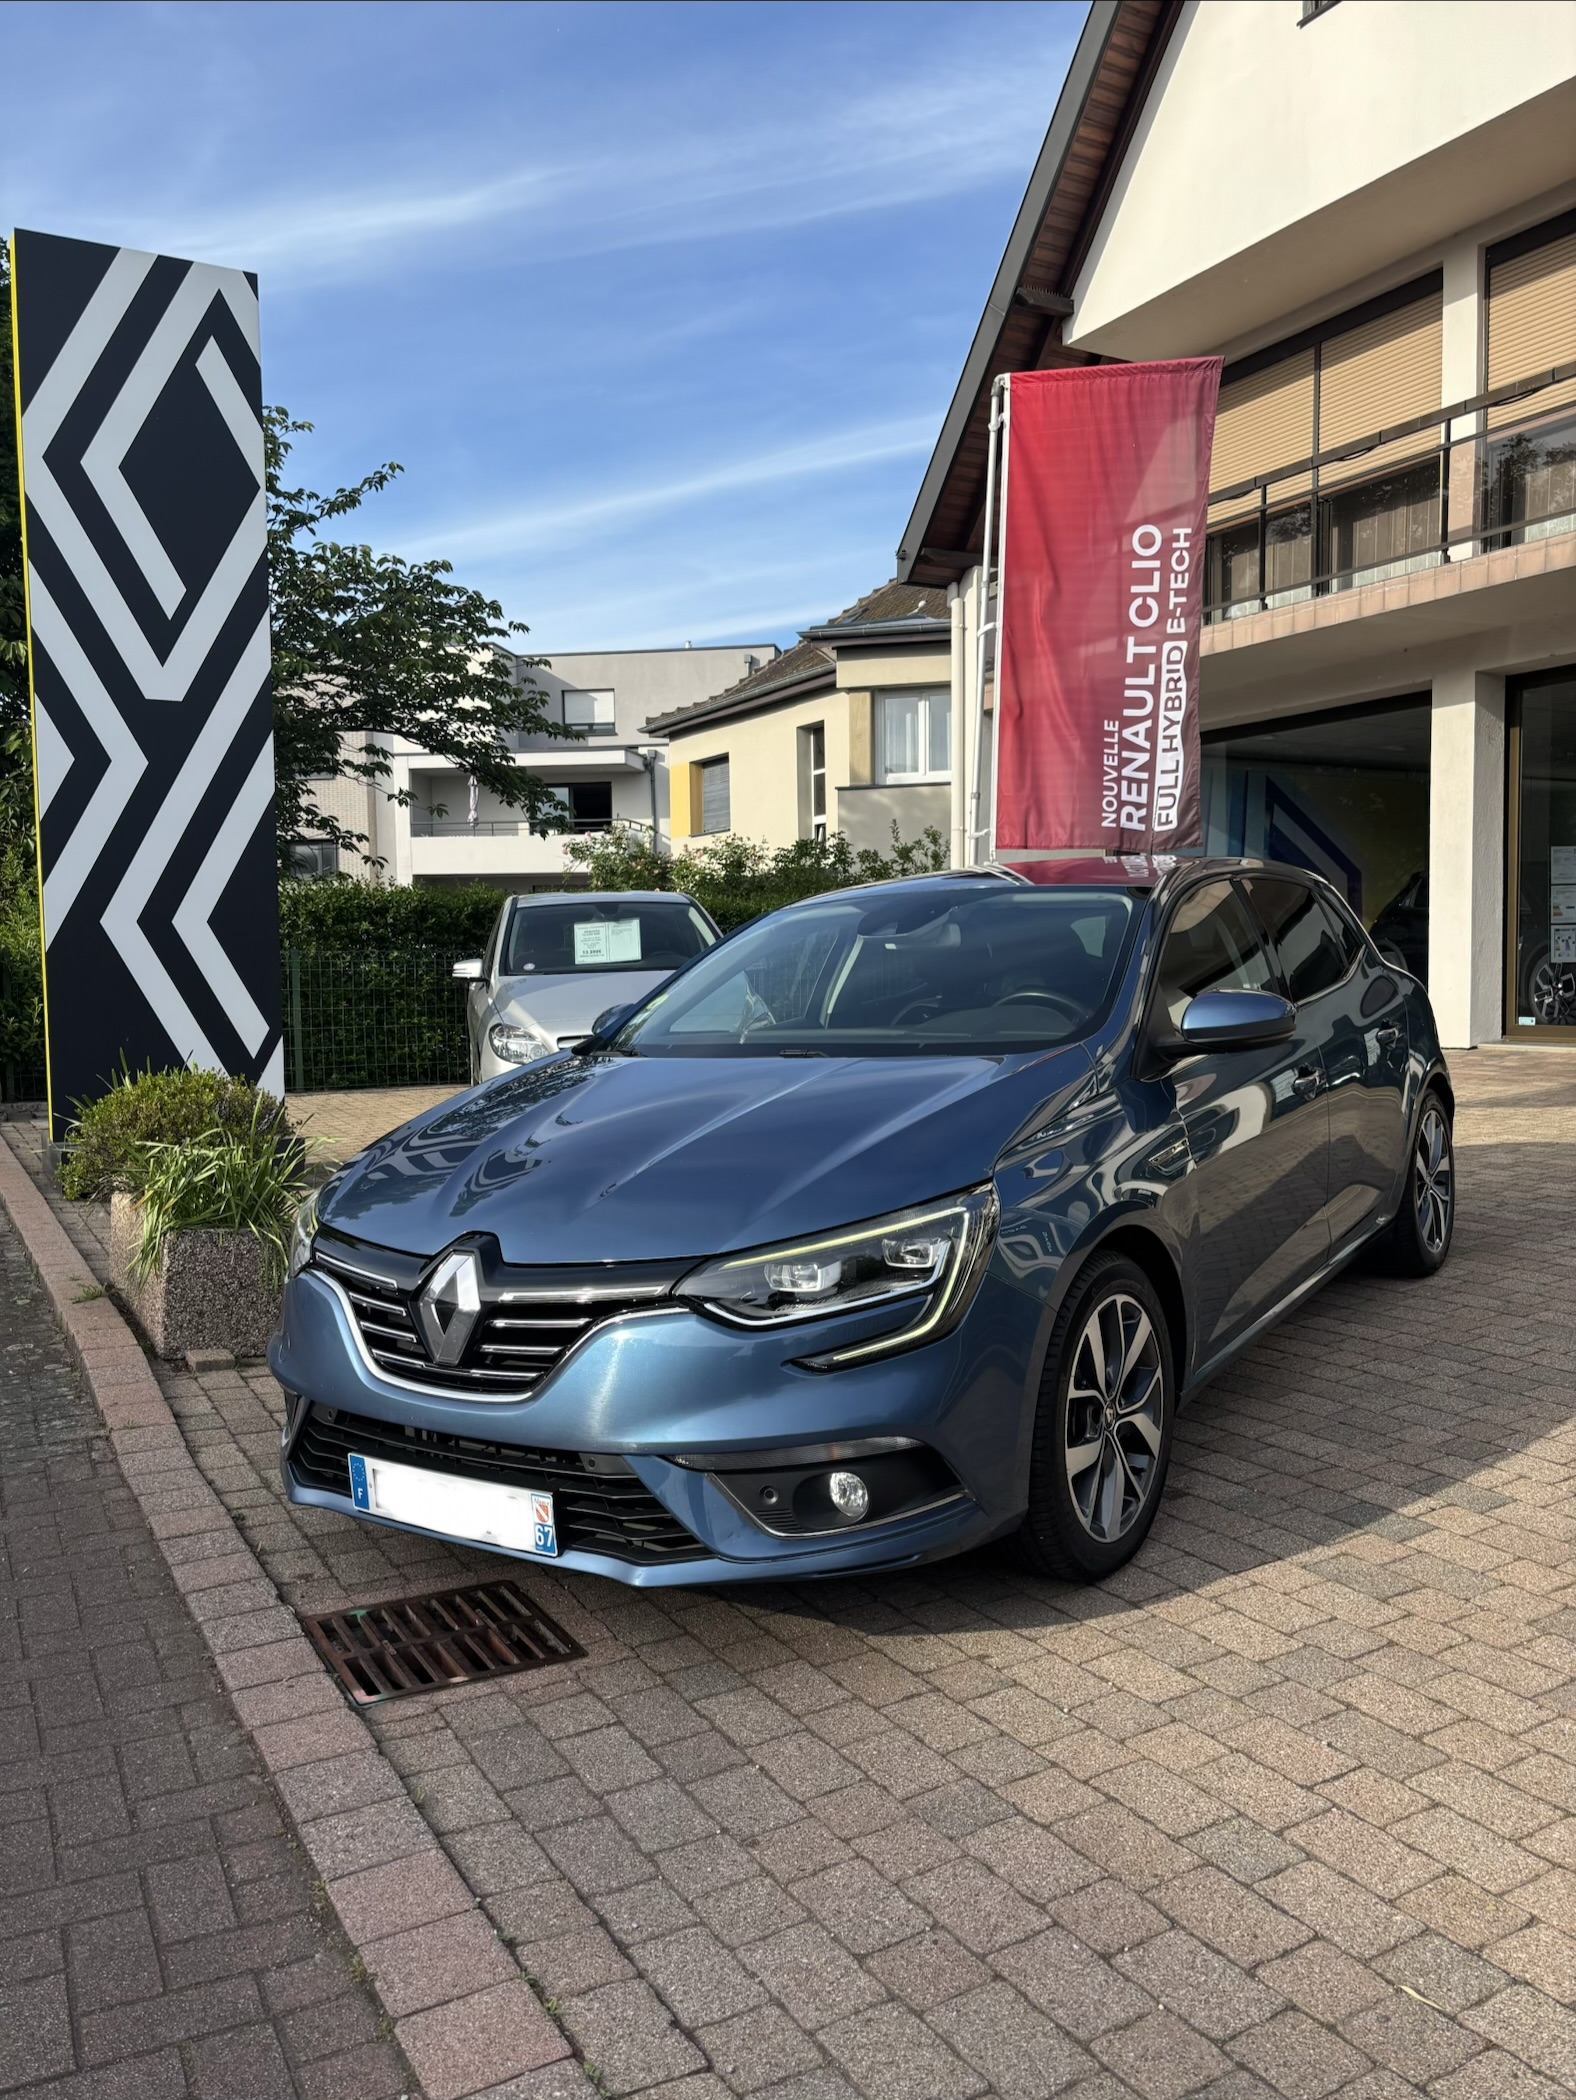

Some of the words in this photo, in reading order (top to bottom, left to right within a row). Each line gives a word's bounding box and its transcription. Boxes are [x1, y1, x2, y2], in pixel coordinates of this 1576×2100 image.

[1128, 524, 1162, 628] CLIO
[1166, 528, 1192, 634] E-TECH
[1120, 636, 1158, 832] RENAULT
[1161, 645, 1184, 754] HYBRID
[1101, 719, 1119, 828] NOUVELLE
[1157, 759, 1180, 827] FULL
[357, 1487, 364, 1500] F
[535, 1524, 553, 1548] 67
